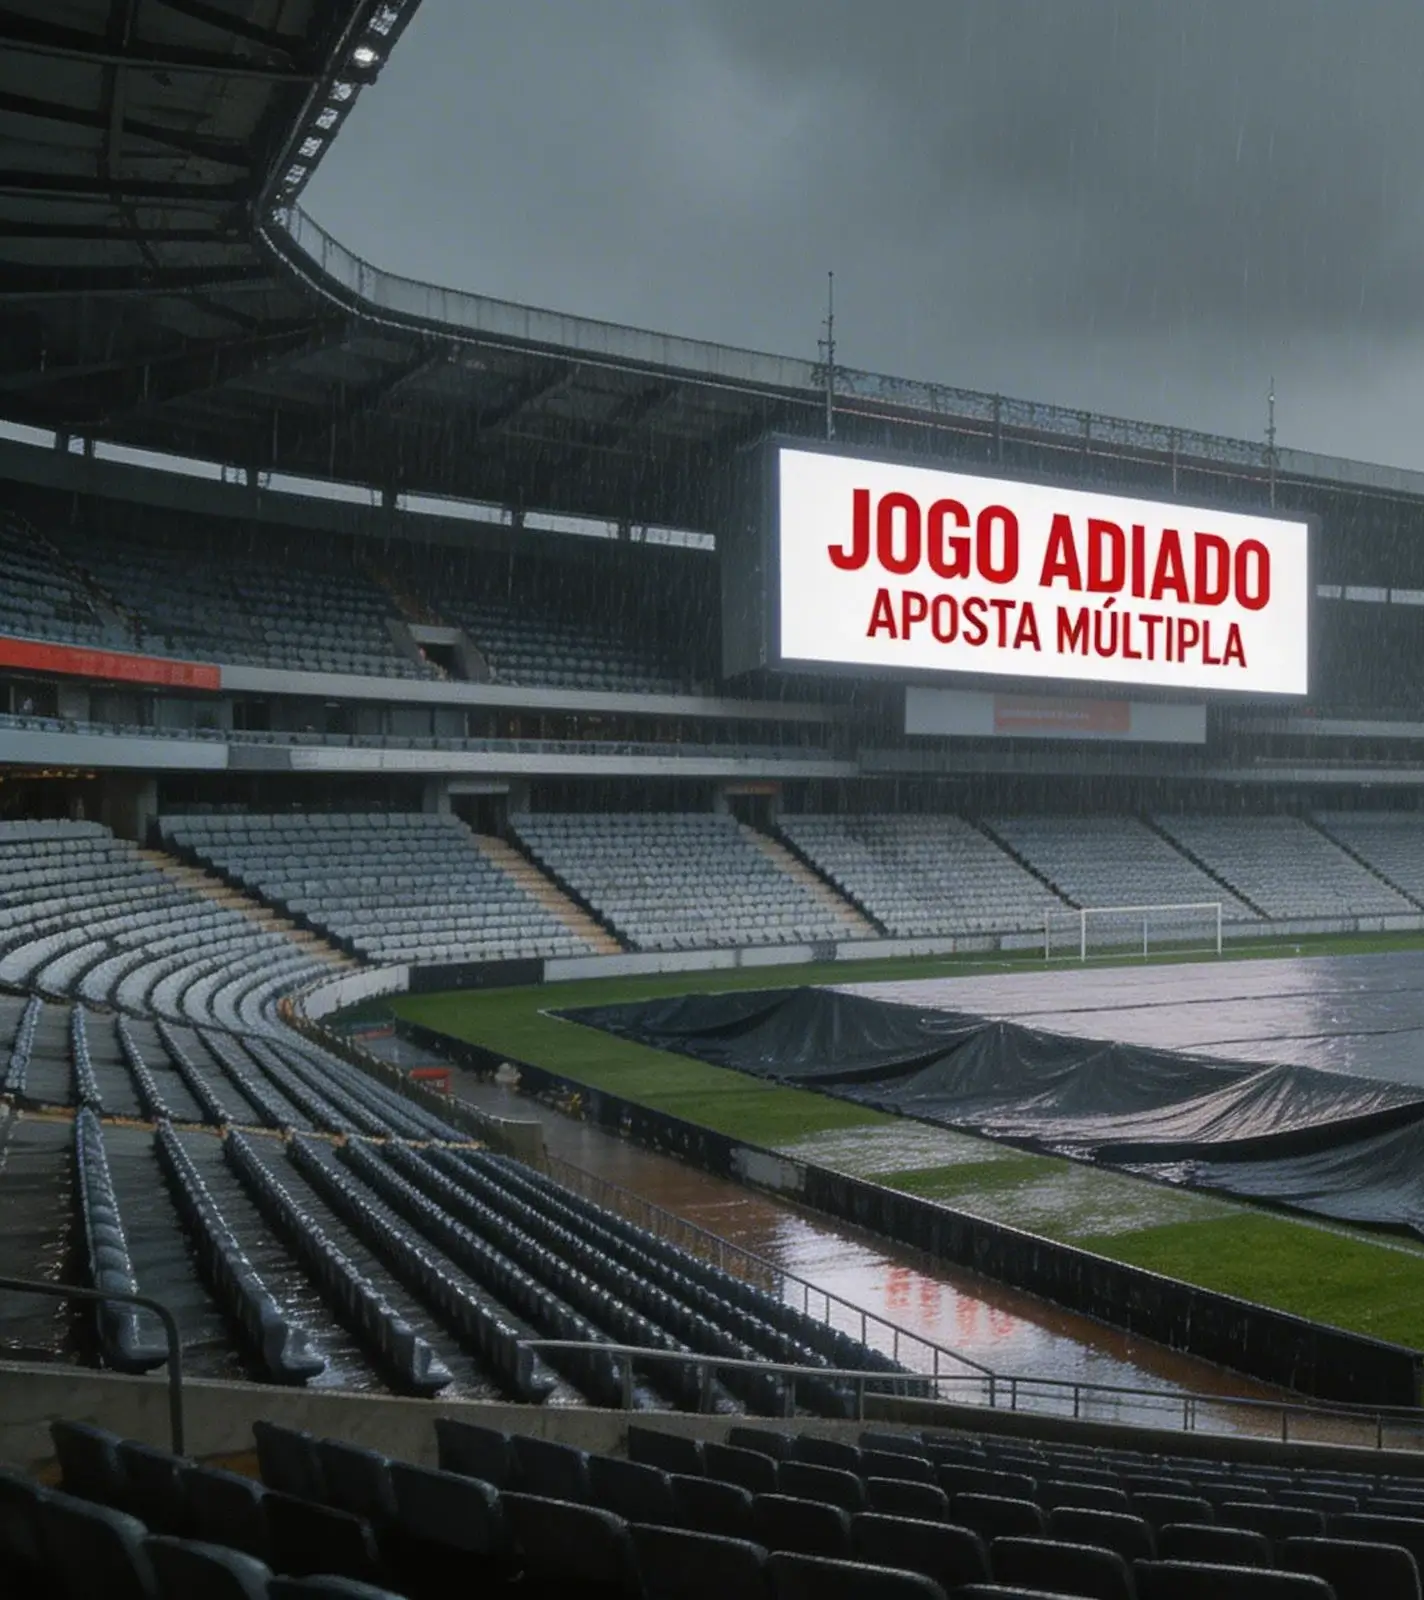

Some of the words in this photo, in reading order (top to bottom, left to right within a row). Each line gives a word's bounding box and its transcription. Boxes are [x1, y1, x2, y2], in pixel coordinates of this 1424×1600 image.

[828, 489, 1020, 584] JOGO
[1039, 513, 1271, 612] ADIADO
[866, 588, 1041, 652] APOSTA
[1057, 597, 1247, 668] MÚLTIPLA
